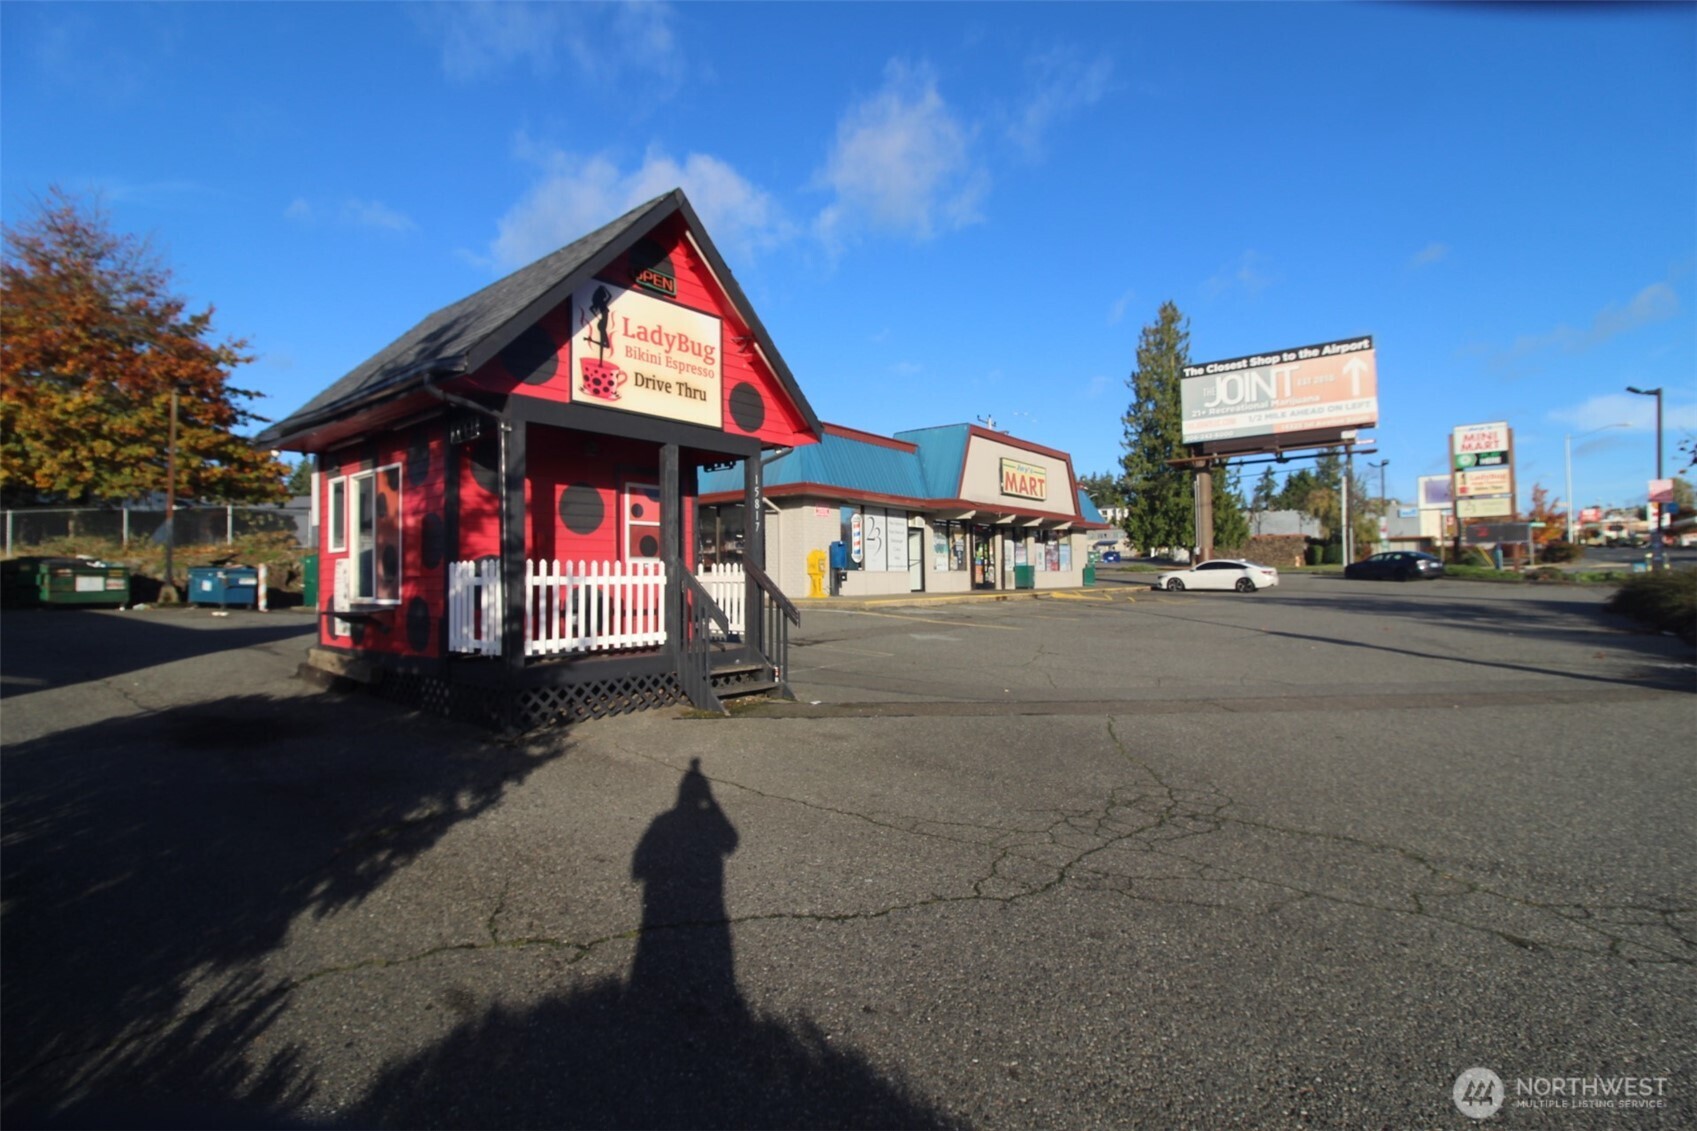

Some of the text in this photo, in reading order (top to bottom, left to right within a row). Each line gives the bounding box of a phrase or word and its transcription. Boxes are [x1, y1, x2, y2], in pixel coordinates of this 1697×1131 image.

[622, 316, 716, 366] LadyBug
[1183, 339, 1370, 377] The Closest Shop to the Airport
[625, 345, 715, 379] Bikini Espresso
[634, 371, 707, 402] Drive Thru
[1204, 365, 1300, 408] JOINT
[1460, 440, 1500, 452] MART
[1463, 431, 1499, 442] MINI
[1004, 471, 1045, 497] MART
[866, 516, 883, 556] 23
